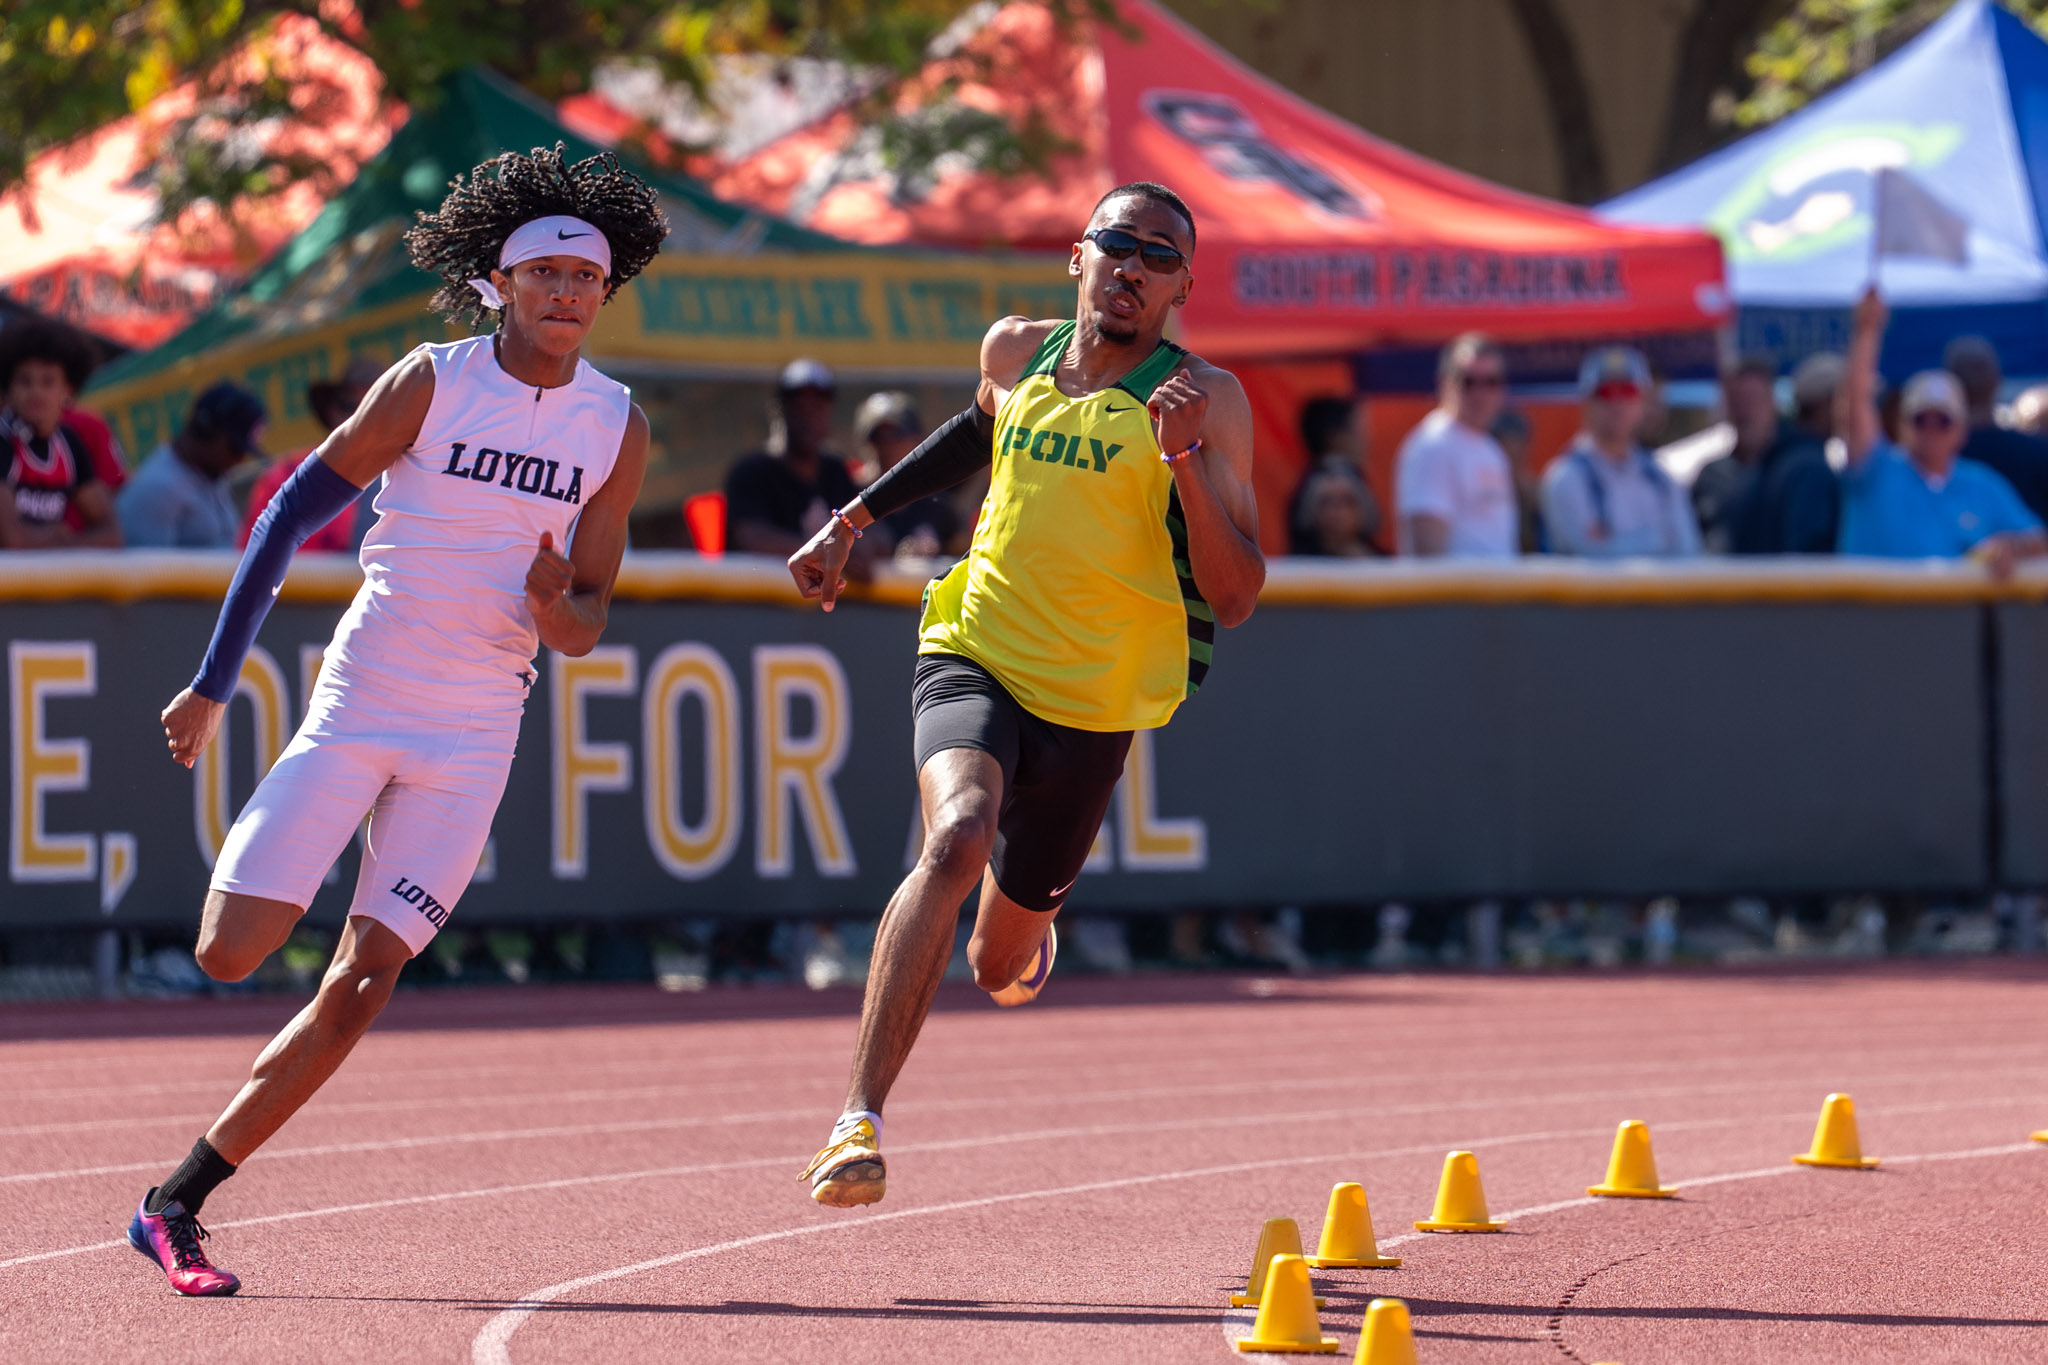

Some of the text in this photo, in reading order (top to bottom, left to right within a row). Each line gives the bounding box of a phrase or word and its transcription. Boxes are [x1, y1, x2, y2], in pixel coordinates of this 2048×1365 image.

[441, 442, 584, 505] LOYOLA
[1002, 425, 1124, 473] POLY
[551, 641, 857, 880] FOR
[390, 877, 449, 930] LOYOL
